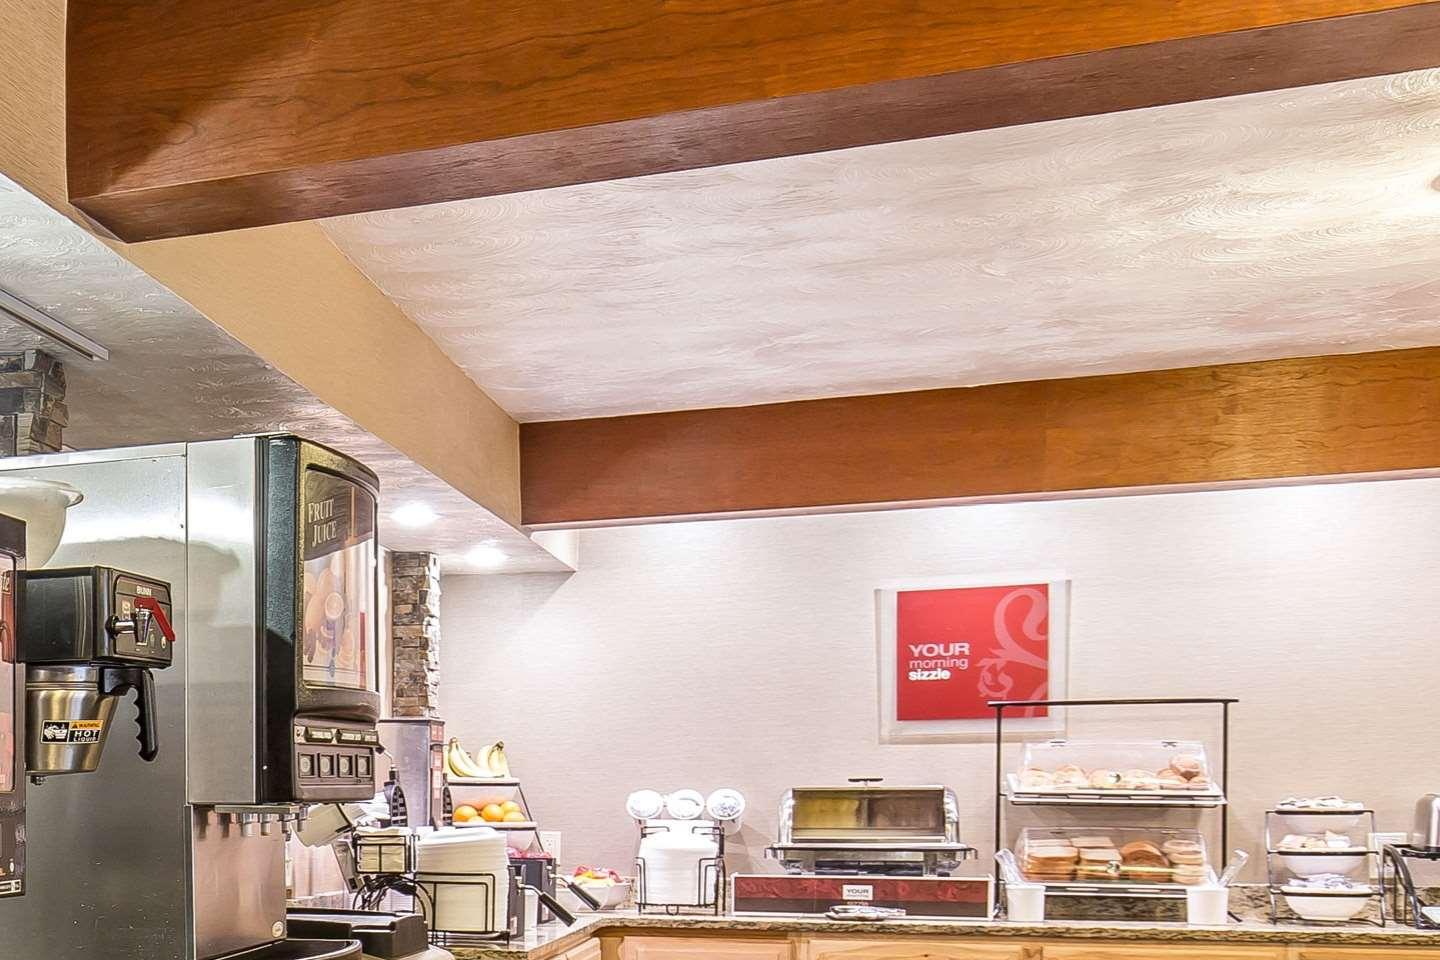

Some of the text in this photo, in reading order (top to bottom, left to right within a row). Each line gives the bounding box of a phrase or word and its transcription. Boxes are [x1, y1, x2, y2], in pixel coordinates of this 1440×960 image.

[308, 498, 335, 523] FRUIT
[312, 520, 337, 548] JUICE
[908, 643, 970, 657] YOUR
[909, 657, 969, 670] morning
[908, 668, 951, 681] sizzle
